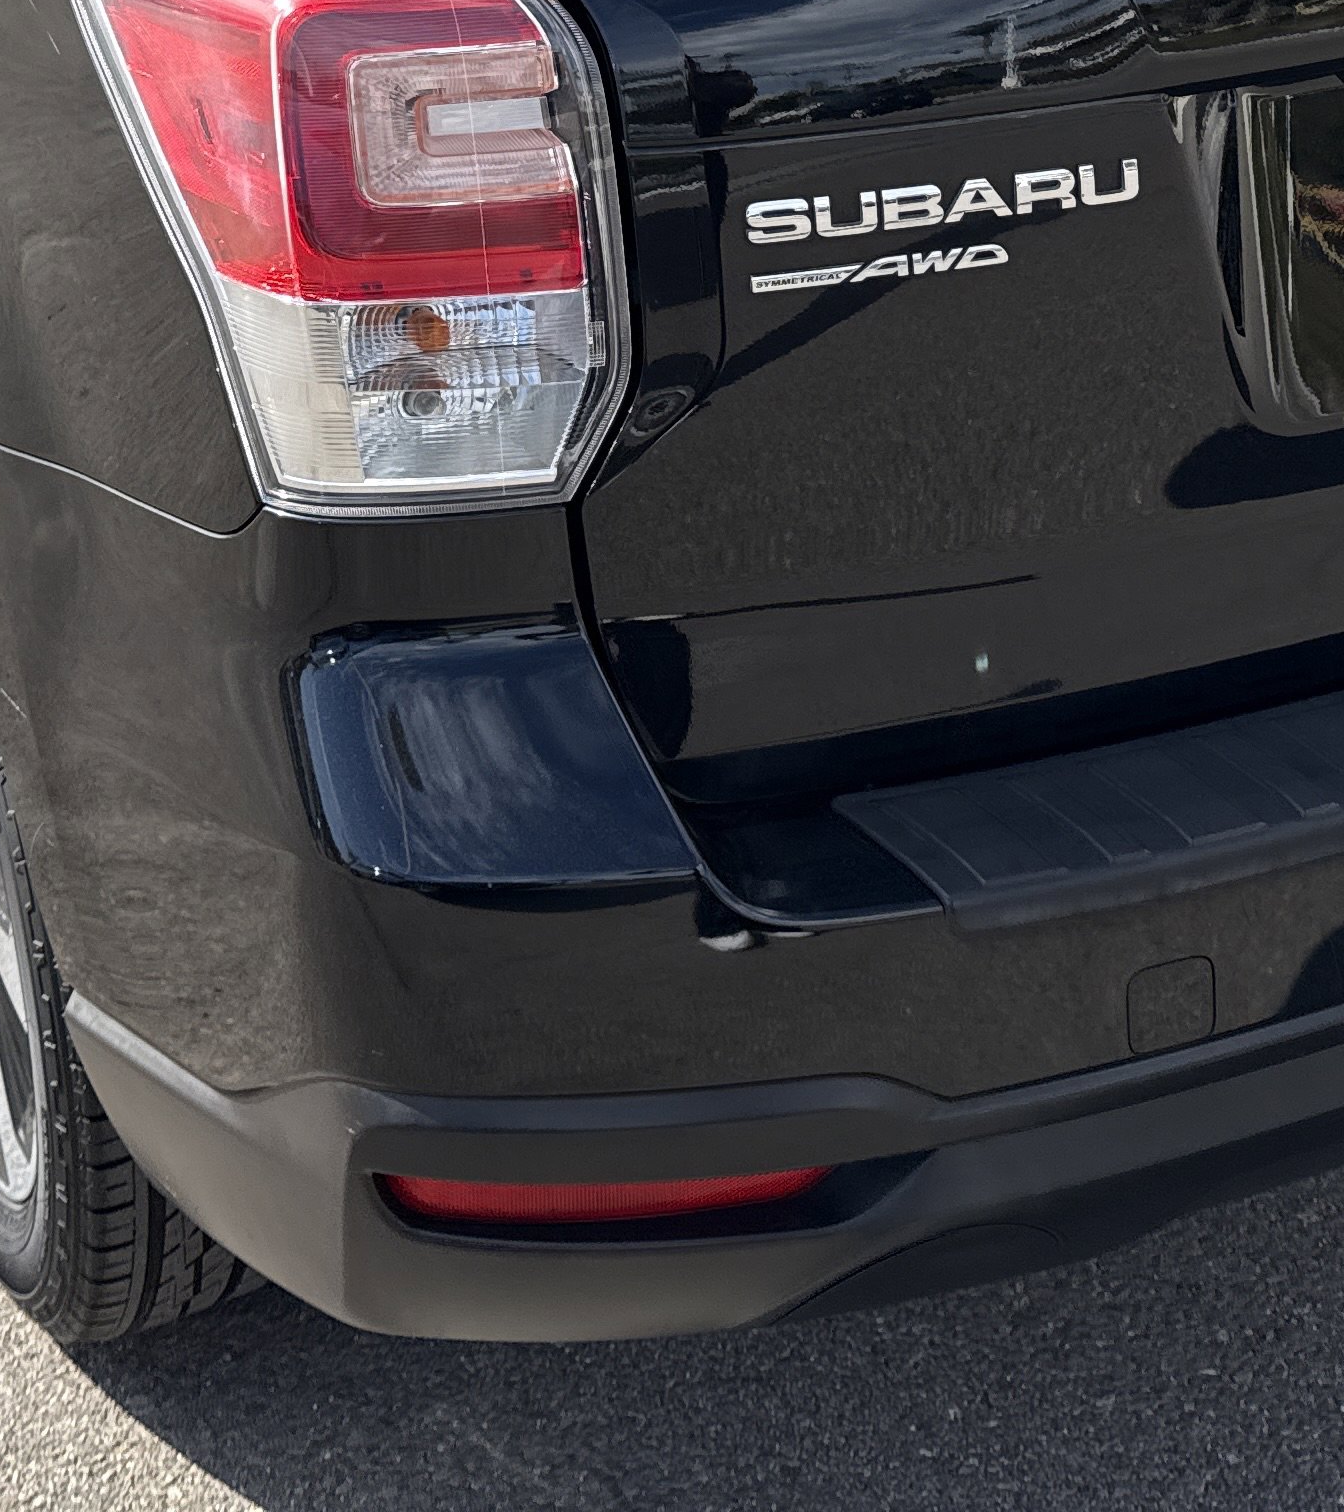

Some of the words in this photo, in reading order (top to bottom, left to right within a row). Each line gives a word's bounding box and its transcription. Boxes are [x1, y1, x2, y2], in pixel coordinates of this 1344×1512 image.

[745, 158, 1140, 244] SUBARU
[755, 272, 844, 289] SYMMETRICAL
[849, 243, 1009, 283] AWD
